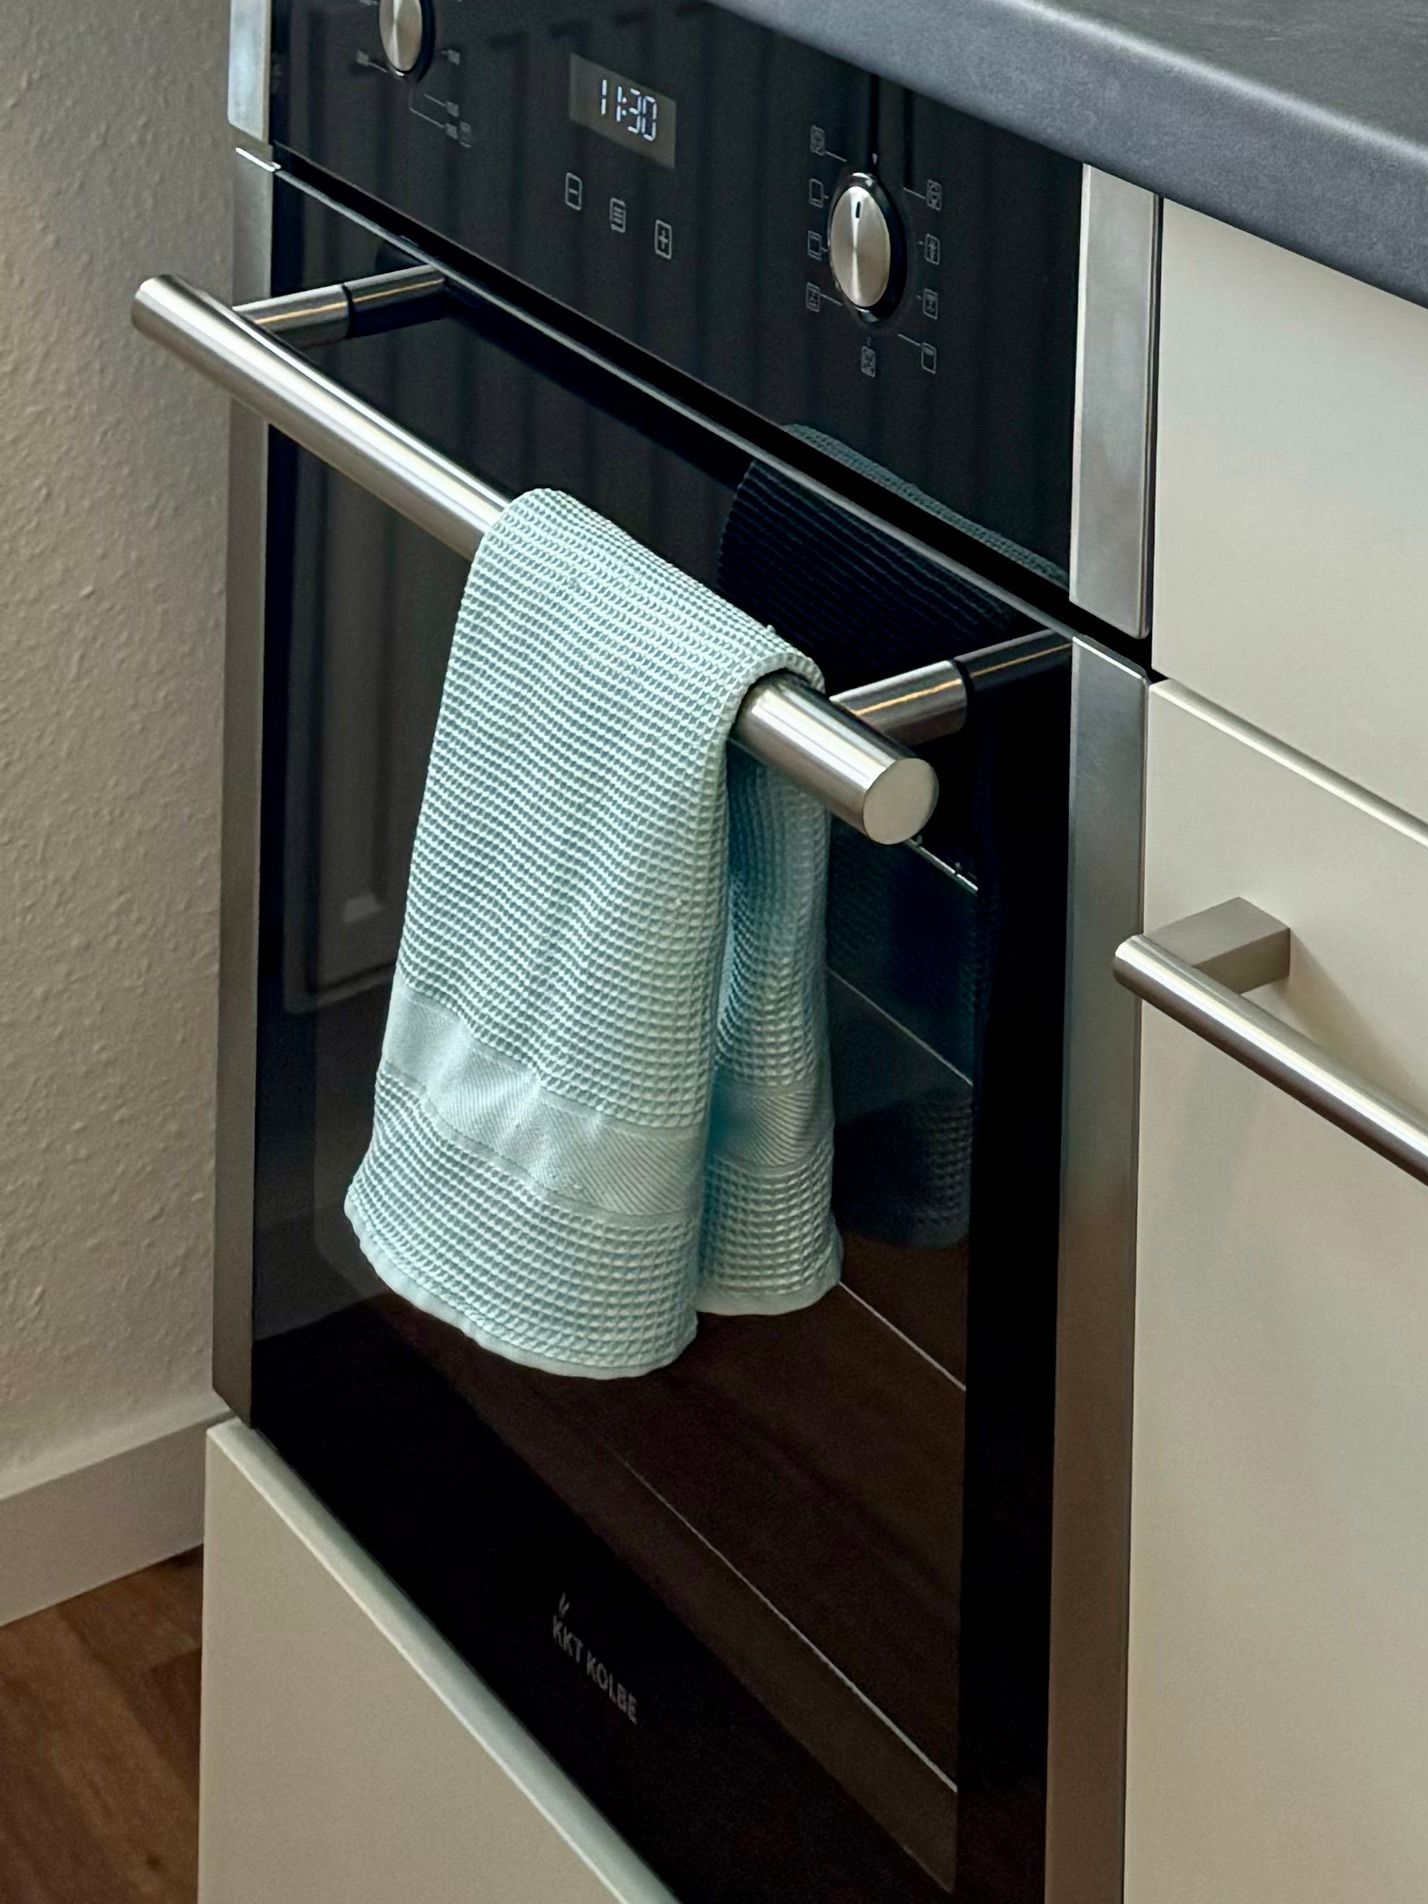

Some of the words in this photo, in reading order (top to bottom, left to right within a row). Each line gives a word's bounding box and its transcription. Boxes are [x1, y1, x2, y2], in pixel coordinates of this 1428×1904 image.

[601, 79, 658, 142] 11:30
[552, 1614, 584, 1664] KKT
[586, 1650, 638, 1726] KOLBE
